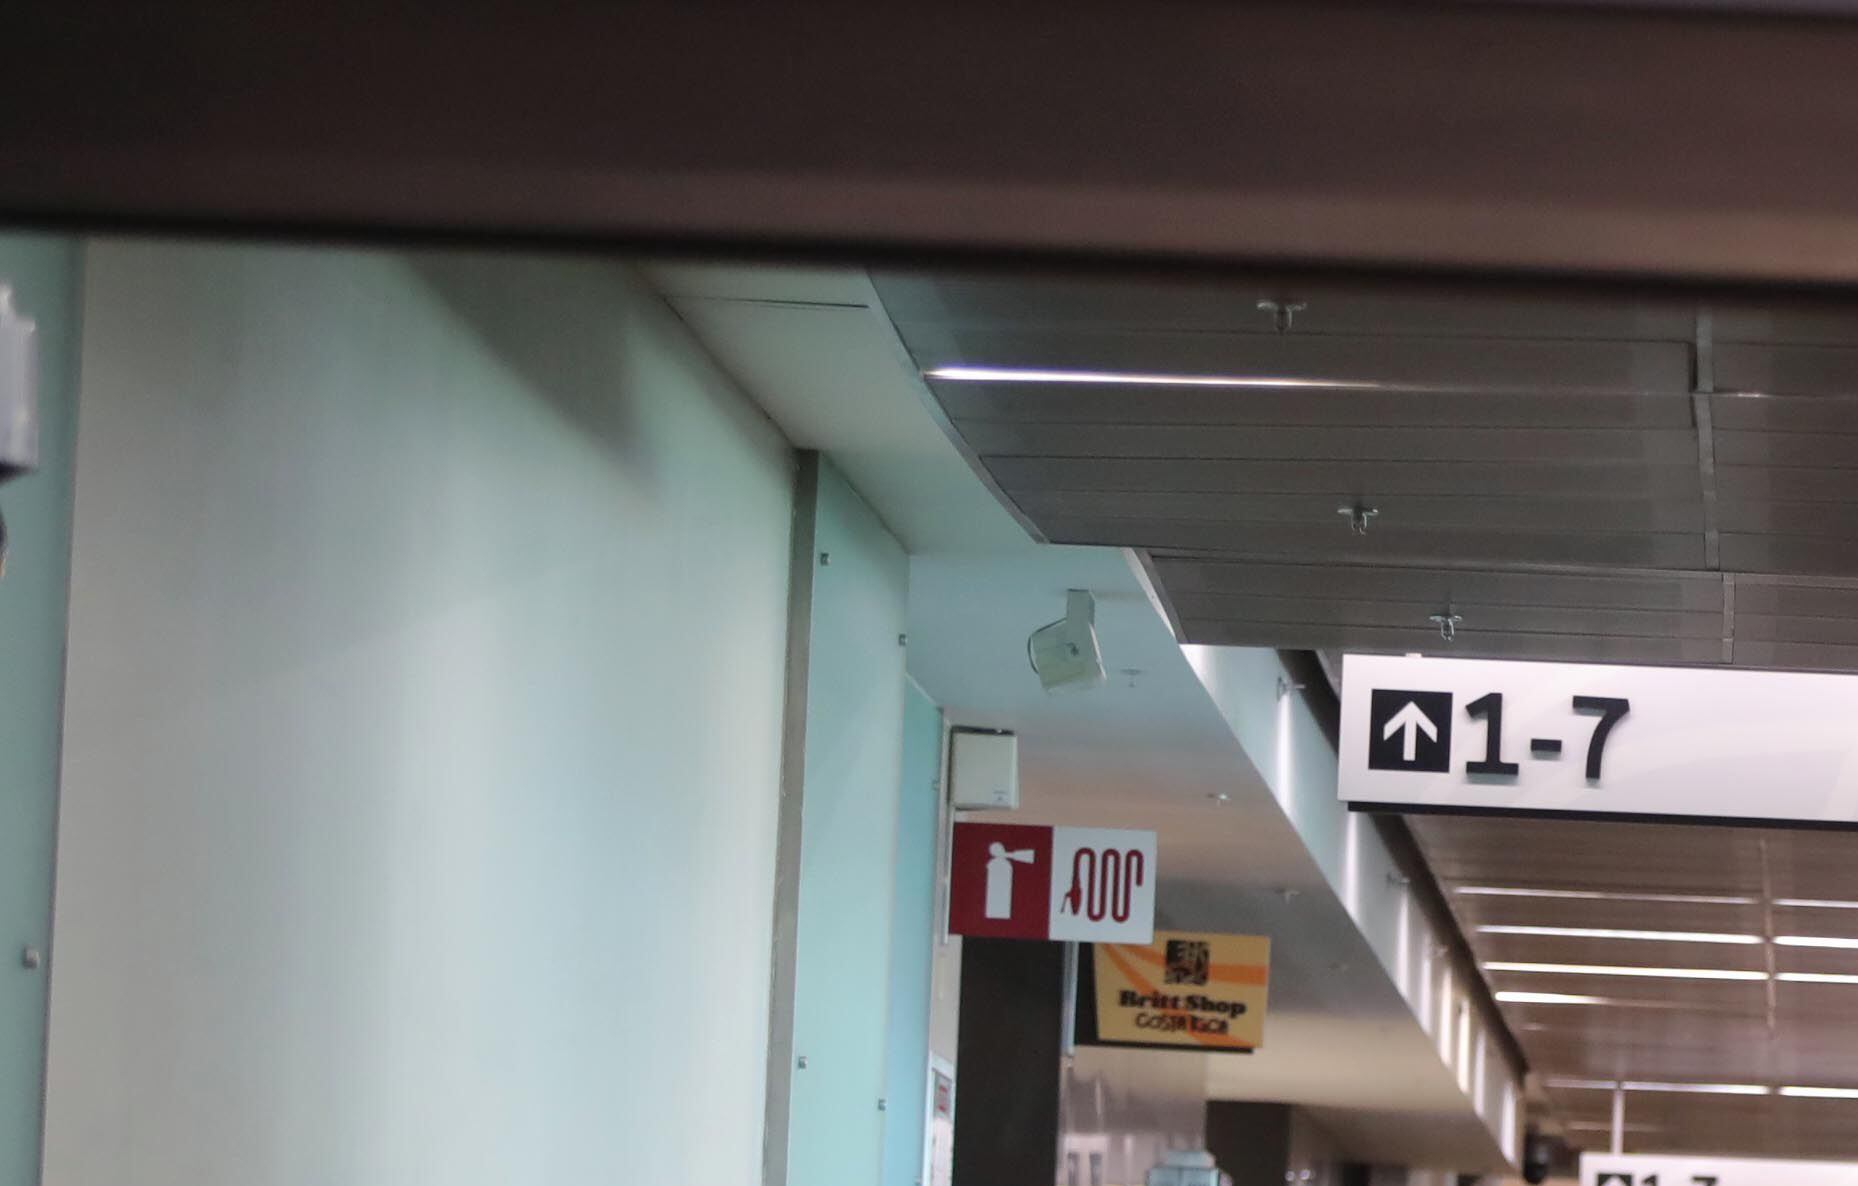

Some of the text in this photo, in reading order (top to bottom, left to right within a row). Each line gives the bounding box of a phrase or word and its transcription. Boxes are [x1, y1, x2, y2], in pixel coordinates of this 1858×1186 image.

[1464, 692, 1631, 780] 1-7
[1119, 989, 1247, 1019] Britt Shop
